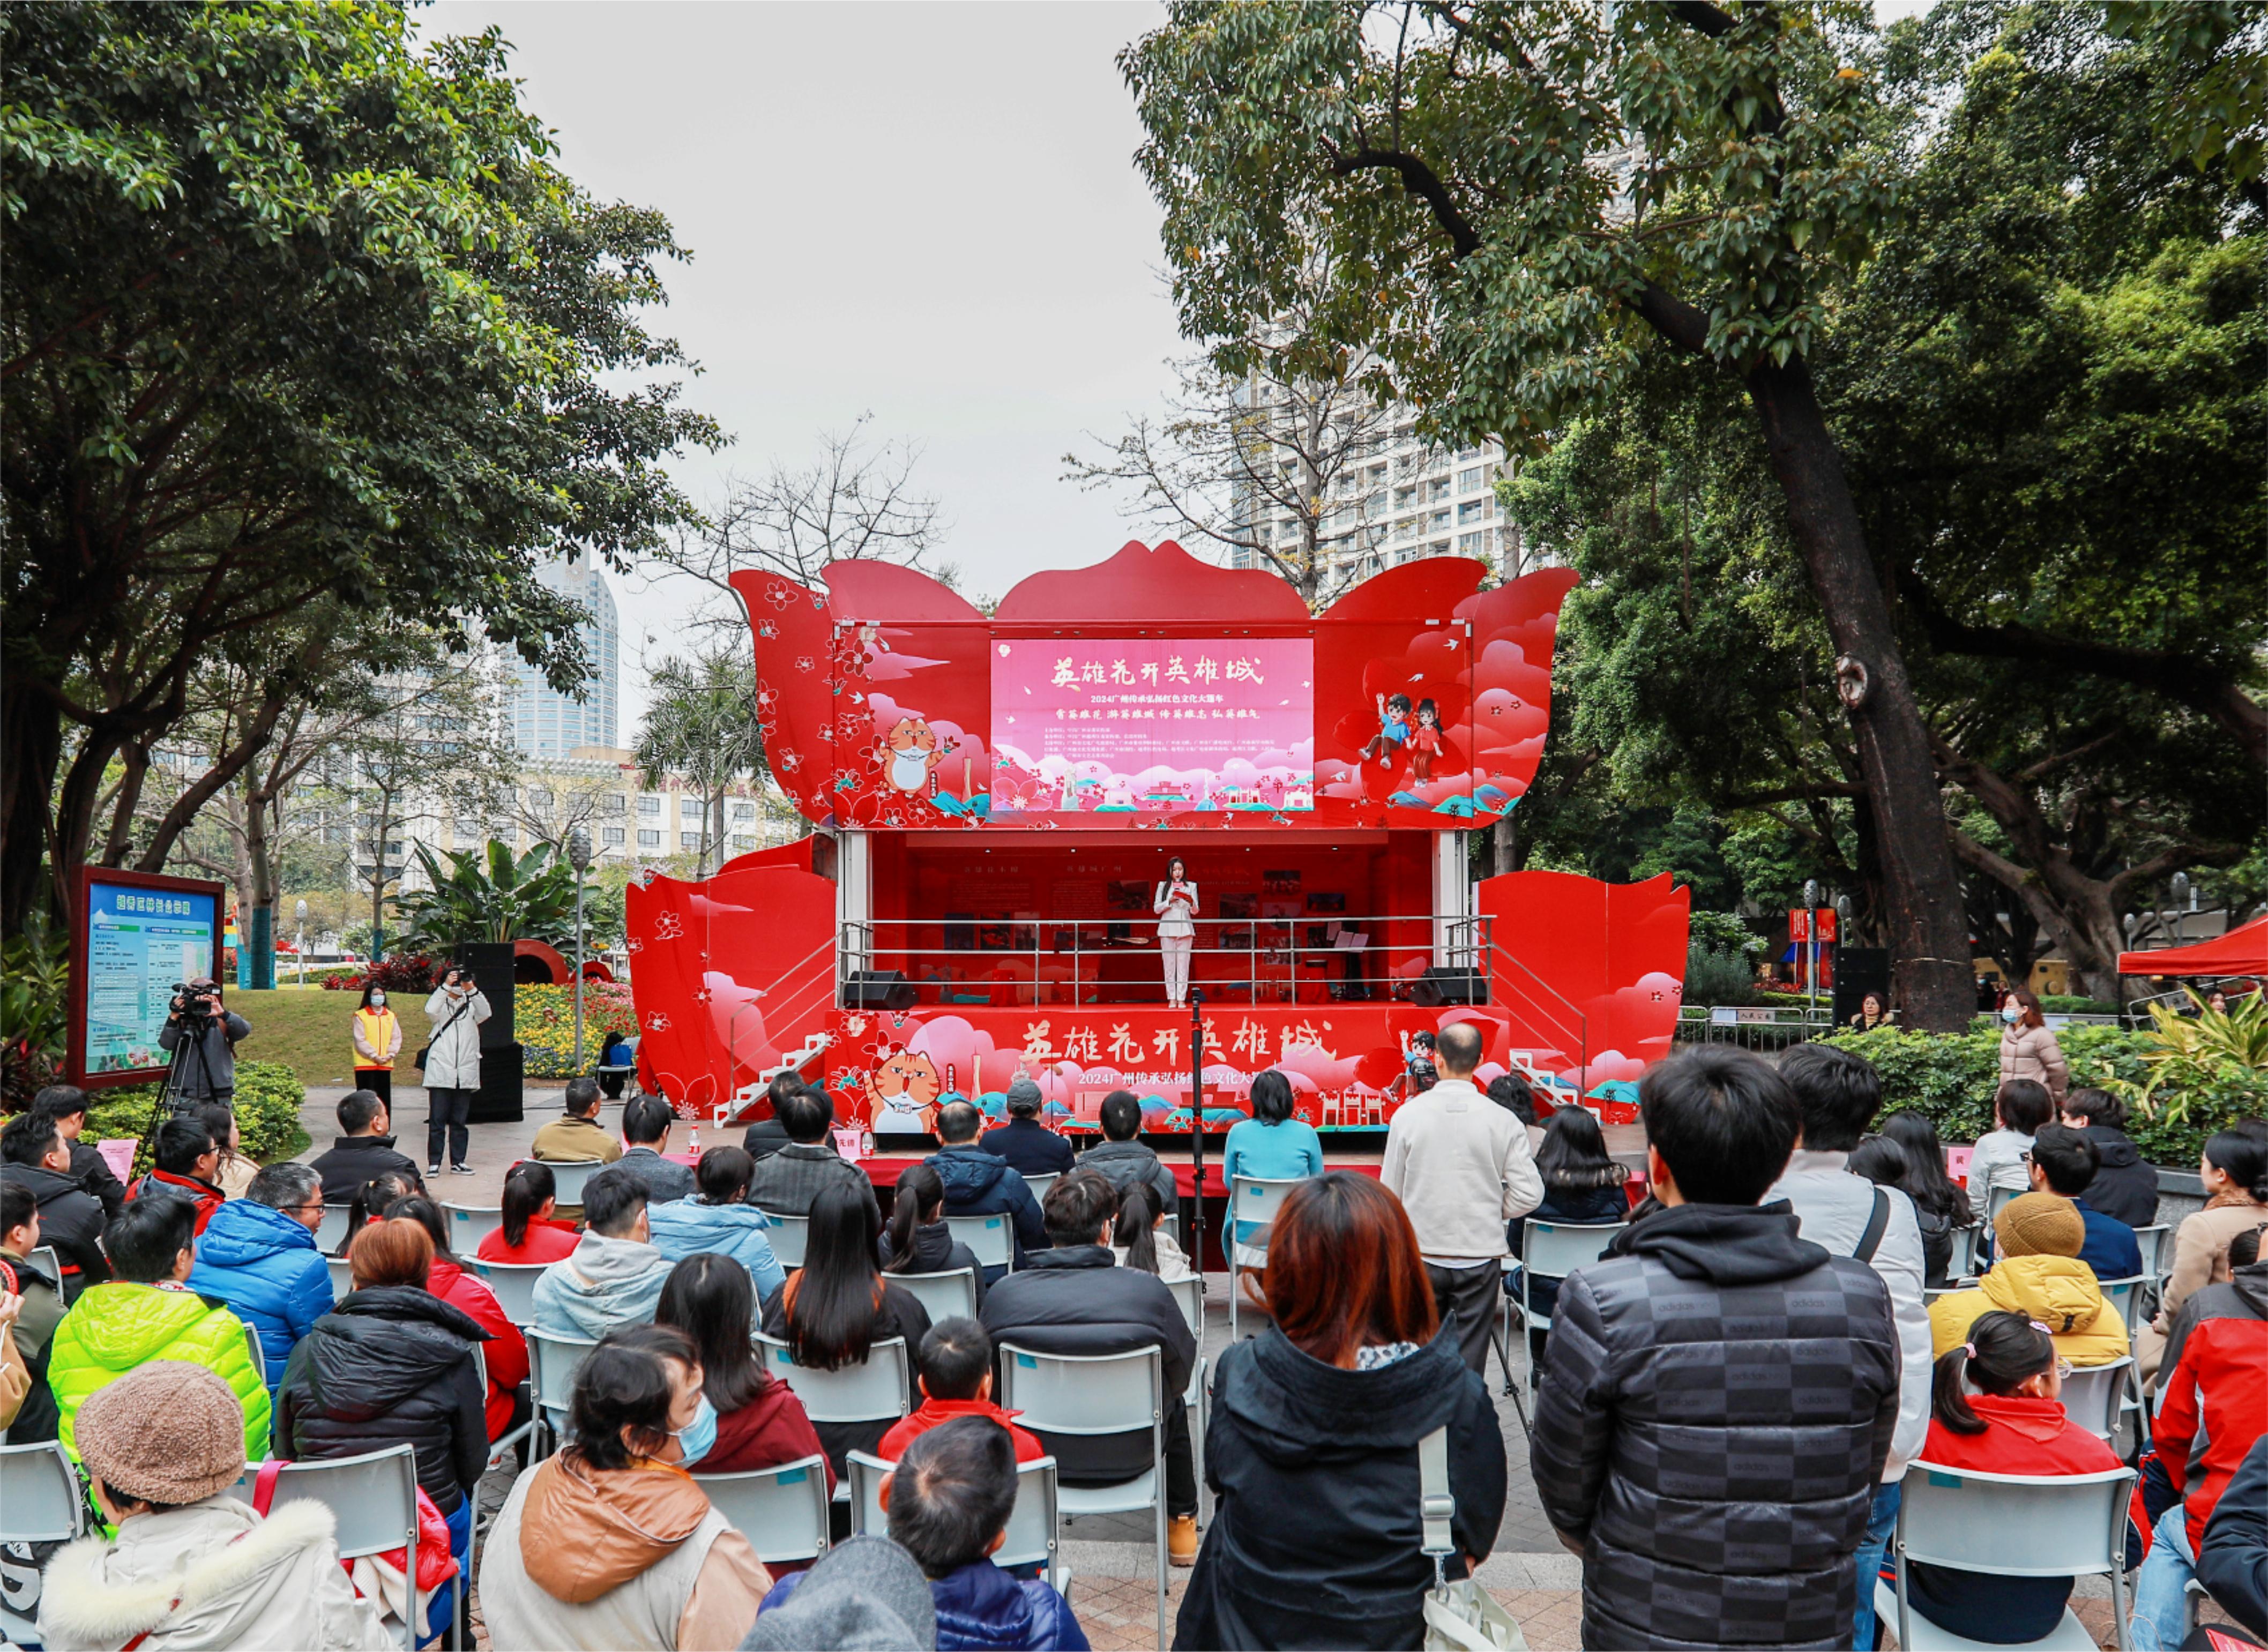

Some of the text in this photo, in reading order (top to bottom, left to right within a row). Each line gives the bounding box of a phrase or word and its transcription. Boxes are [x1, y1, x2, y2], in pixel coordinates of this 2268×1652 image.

[1051, 655, 1264, 692] 英雄花开英雄城
[1658, 1302, 1695, 1311] adidas
[1792, 1299, 1825, 1308] adidas
[1734, 1462, 1770, 1471] adidas
